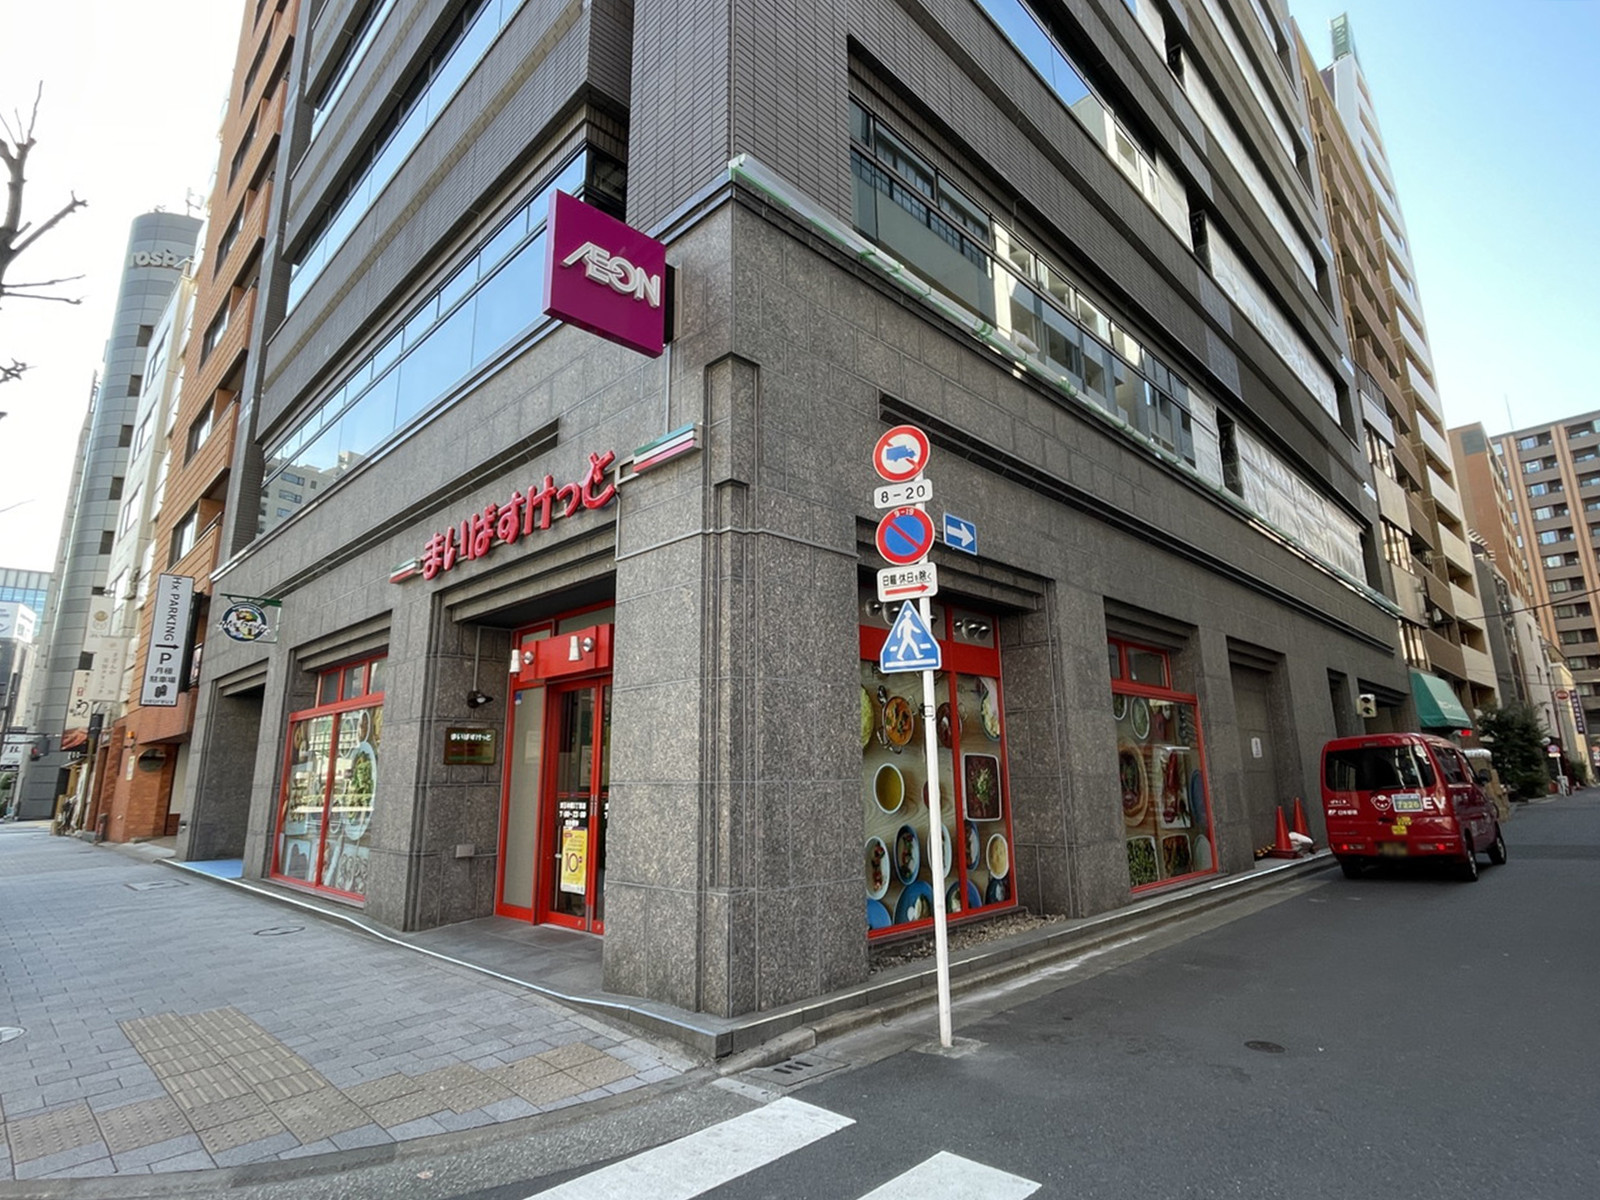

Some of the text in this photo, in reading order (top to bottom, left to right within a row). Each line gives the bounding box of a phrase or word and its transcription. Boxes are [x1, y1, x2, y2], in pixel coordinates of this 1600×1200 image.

[880, 484, 926, 504] 8-20
[420, 449, 616, 581] まいばすけっと
[163, 593, 181, 642] PARKING
[159, 652, 172, 665] P
[1422, 796, 1447, 810] EV
